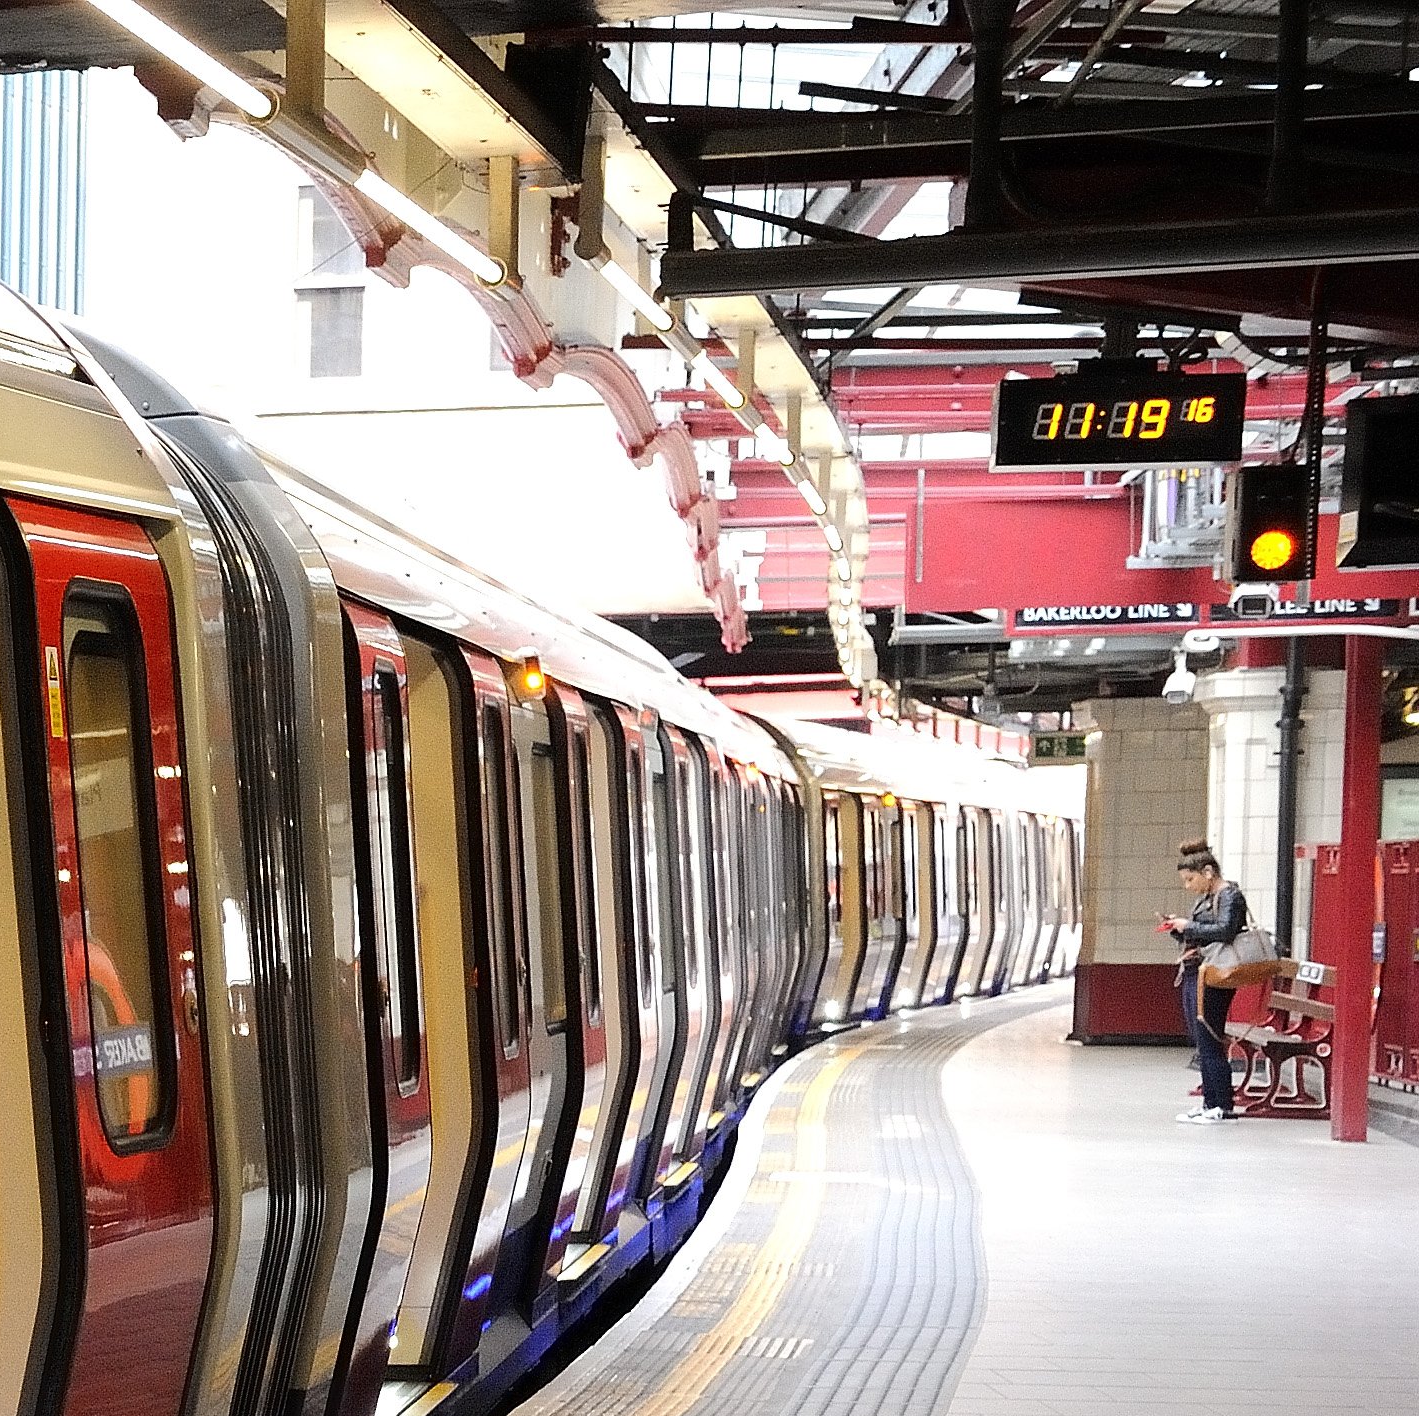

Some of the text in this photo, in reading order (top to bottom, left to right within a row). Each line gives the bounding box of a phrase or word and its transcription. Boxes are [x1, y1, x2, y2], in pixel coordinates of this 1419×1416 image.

[1032, 397, 1216, 440] 11:19 16
[1023, 603, 1170, 622] BAKERLOO LINE
[1314, 599, 1358, 613] LINE
